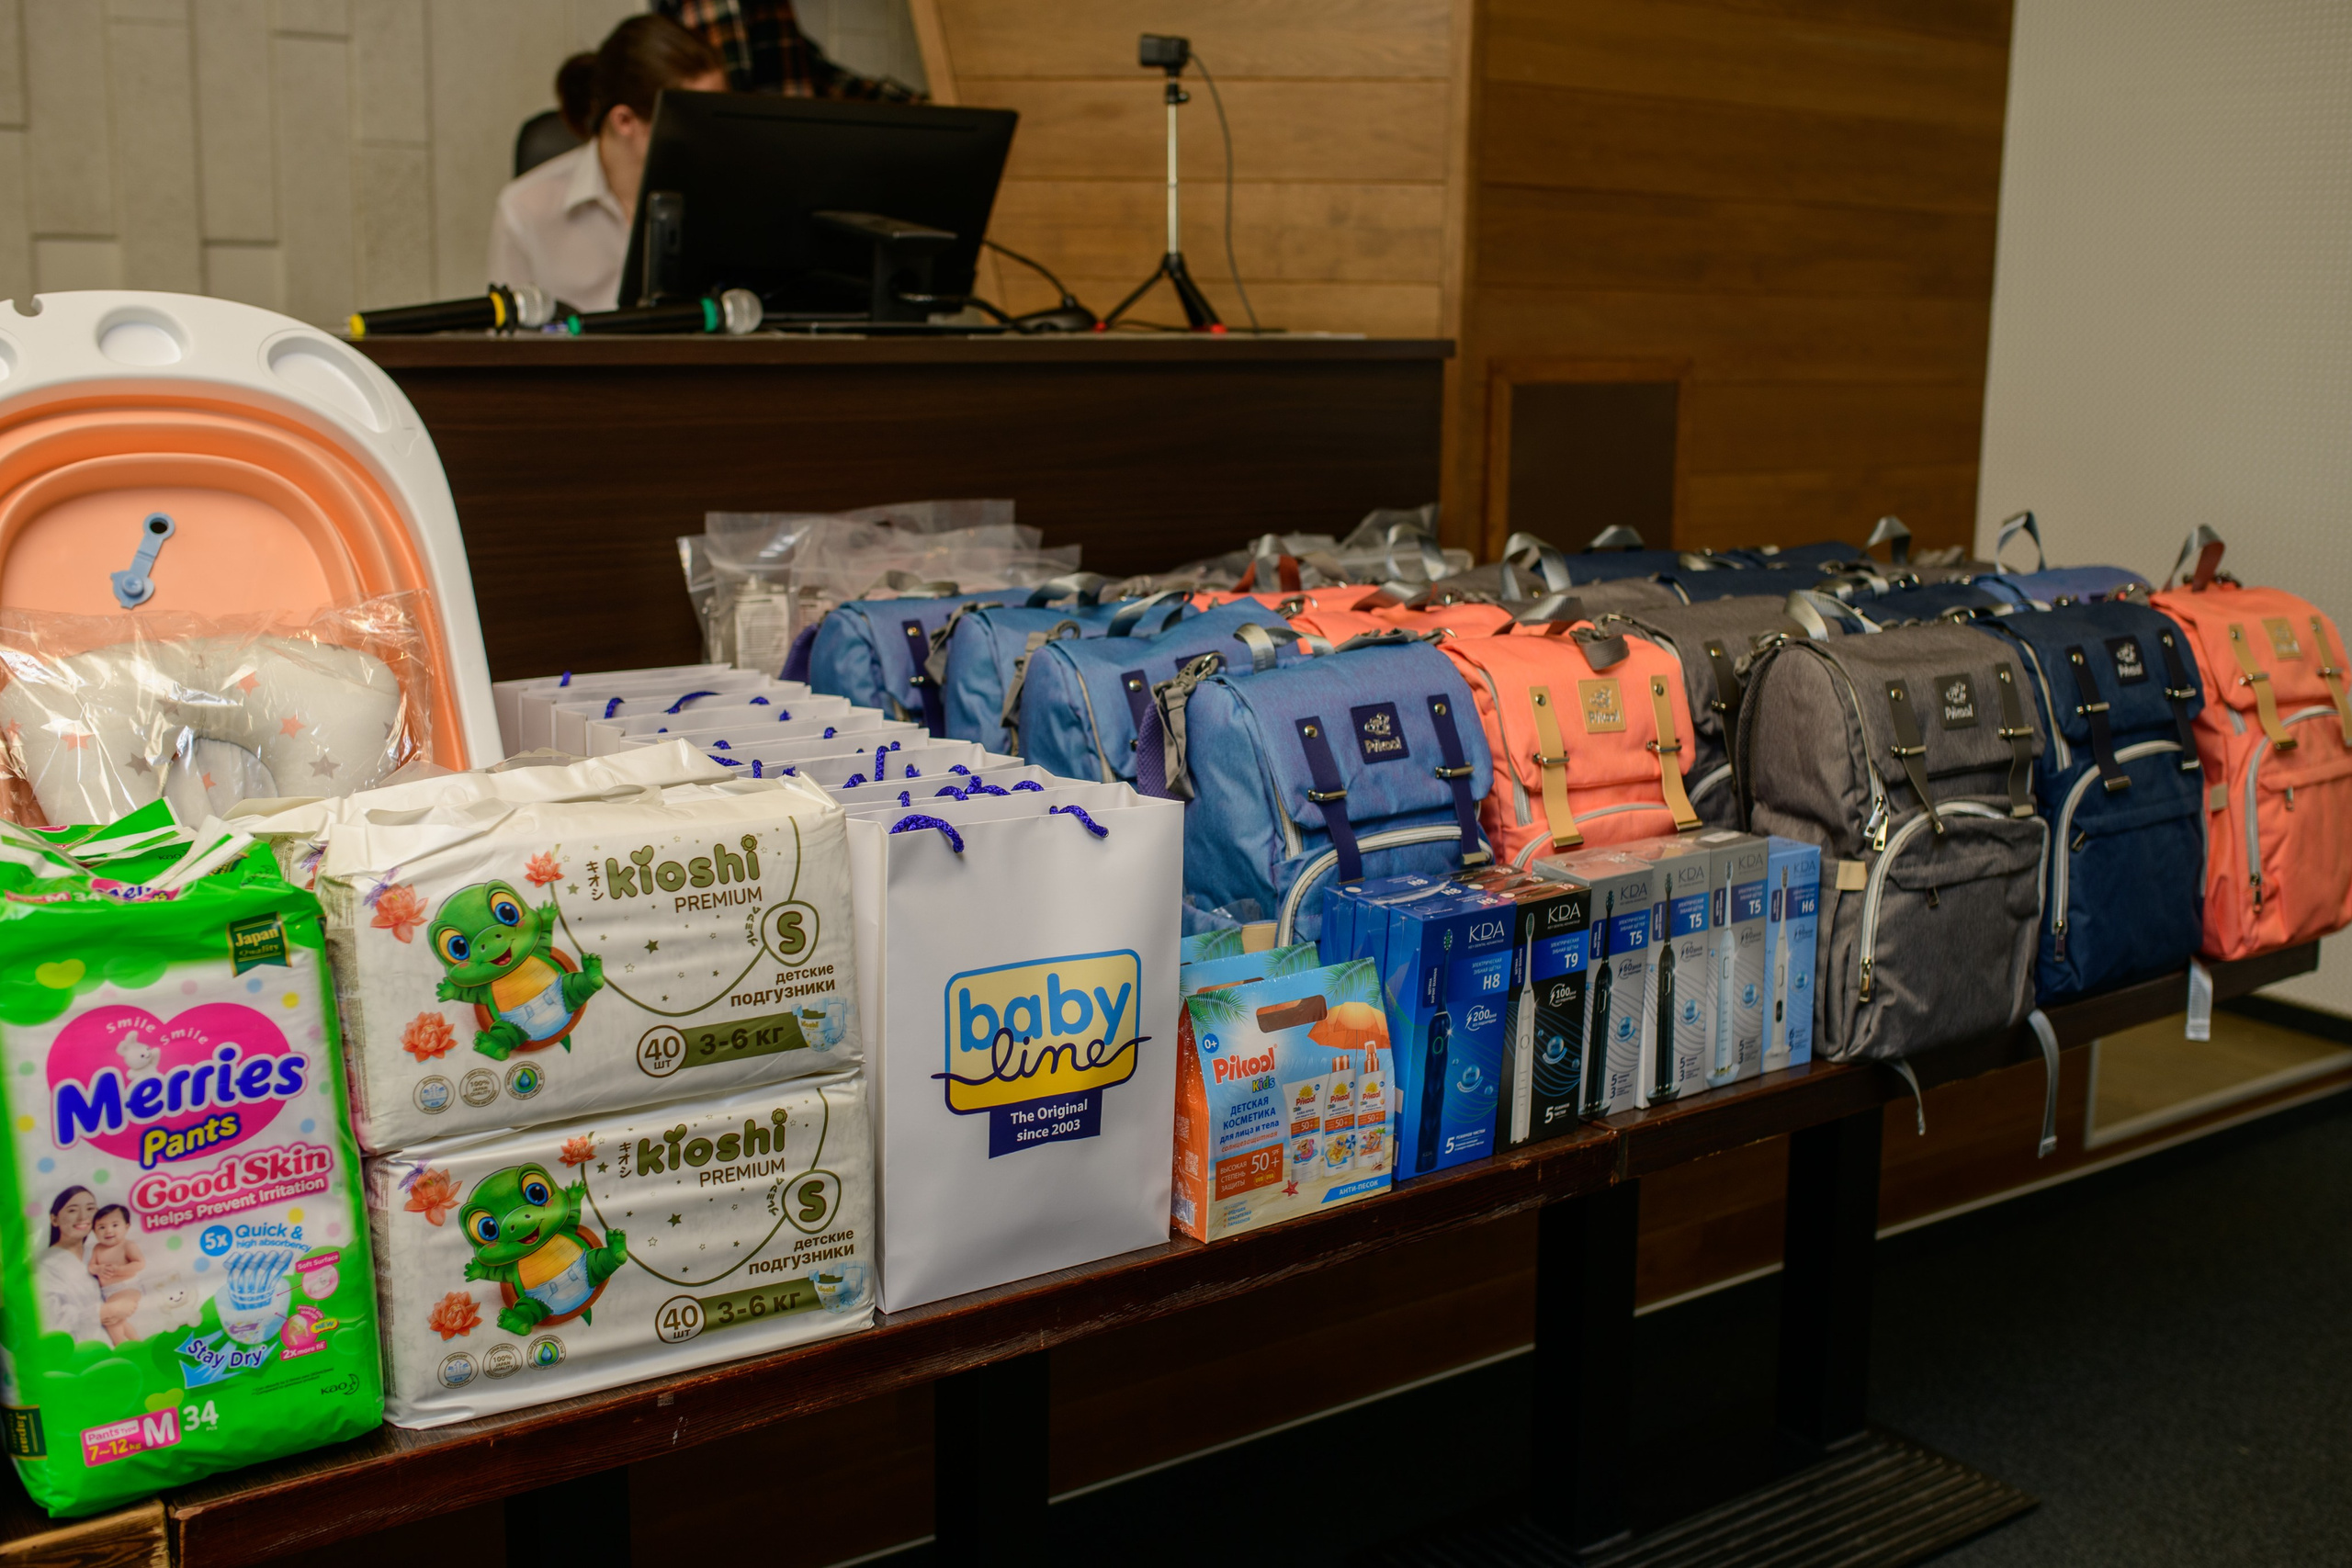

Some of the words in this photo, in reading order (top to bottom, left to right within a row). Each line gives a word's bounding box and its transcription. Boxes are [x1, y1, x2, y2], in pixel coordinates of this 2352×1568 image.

[1363, 736, 1402, 754] Pikool
[605, 834, 761, 900] kioshi
[1738, 853, 1763, 870] KDA
[586, 860, 604, 901] キオシ
[1678, 865, 1704, 883] KDA
[674, 886, 763, 913] PREMIUM
[1620, 882, 1647, 901] KDA
[1547, 902, 1581, 924] KDA
[1749, 899, 1761, 915] T5
[1802, 899, 1815, 914] H6
[1689, 912, 1702, 929] T5
[235, 928, 279, 947] Japan
[776, 910, 806, 955] S
[1468, 920, 1505, 943] KDA
[1629, 930, 1643, 946] T5
[239, 944, 279, 956] Quality
[1565, 953, 1578, 969] T9
[1623, 962, 1633, 972] 60
[775, 964, 834, 985] детские
[1483, 973, 1500, 990] H8
[730, 979, 836, 1008] подгузники
[1555, 987, 1571, 998] 100
[958, 973, 1132, 1053] baby
[1473, 1009, 1490, 1022] 200
[644, 1035, 681, 1061] 40
[699, 1028, 749, 1055] 3-6
[756, 1026, 784, 1046] кг
[1204, 1038, 1217, 1049] 0+
[931, 1027, 1152, 1086] line
[1212, 1046, 1275, 1085] Pikool
[1251, 1075, 1276, 1093] Kids
[55, 1045, 306, 1145] Merries
[1011, 1108, 1035, 1124] The
[1036, 1099, 1088, 1121] Original
[1230, 1096, 1269, 1117] ДЕТСКАЯ
[1544, 1105, 1555, 1124] 5
[1223, 1107, 1276, 1131] КОСМЕТИКА
[141, 1113, 240, 1168] Pants
[1016, 1122, 1049, 1142] since
[1051, 1119, 1080, 1136] 2003
[1219, 1134, 1234, 1145] для
[1235, 1128, 1254, 1140] лица
[1261, 1120, 1280, 1131] тела
[637, 1107, 788, 1177] kioshi
[1221, 1131, 1278, 1153] солнцезащитная
[1444, 1136, 1455, 1155] 5
[617, 1141, 632, 1179] キオシ
[1220, 1160, 1248, 1175] ВЫСОКАЯ
[137, 1161, 237, 1210] Good
[241, 1147, 328, 1185] Skin
[699, 1157, 786, 1188] PREMIUM
[1220, 1170, 1247, 1183] СТЕПЕНЬ
[1221, 1179, 1246, 1192] ЗАЩИТЫ
[1339, 1179, 1379, 1196] АНТИ-ПЕСОК
[146, 1208, 193, 1228] Helps
[196, 1192, 256, 1218] Prevent
[259, 1177, 325, 1203] Irritation
[797, 1179, 827, 1223] S
[204, 1232, 229, 1250] 5x
[235, 1223, 288, 1238] Quick
[290, 1225, 303, 1240] &
[794, 1229, 854, 1252] детские
[236, 1239, 258, 1249] high
[259, 1238, 312, 1253] absorbency
[297, 1259, 313, 1270] Soft
[313, 1253, 339, 1267] Surface
[749, 1243, 854, 1275] подгузники
[662, 1304, 699, 1331] 40
[717, 1294, 766, 1324] 3-6
[773, 1292, 801, 1313] кг
[314, 1320, 335, 1331] NEW
[187, 1339, 225, 1369] Stay
[231, 1348, 265, 1367] Dry
[492, 1354, 513, 1363] 100%
[492, 1364, 514, 1372] QUALITY
[183, 1400, 220, 1431] 34
[16, 1412, 29, 1453] Japan
[87, 1427, 120, 1442] Pants
[142, 1412, 175, 1448] M
